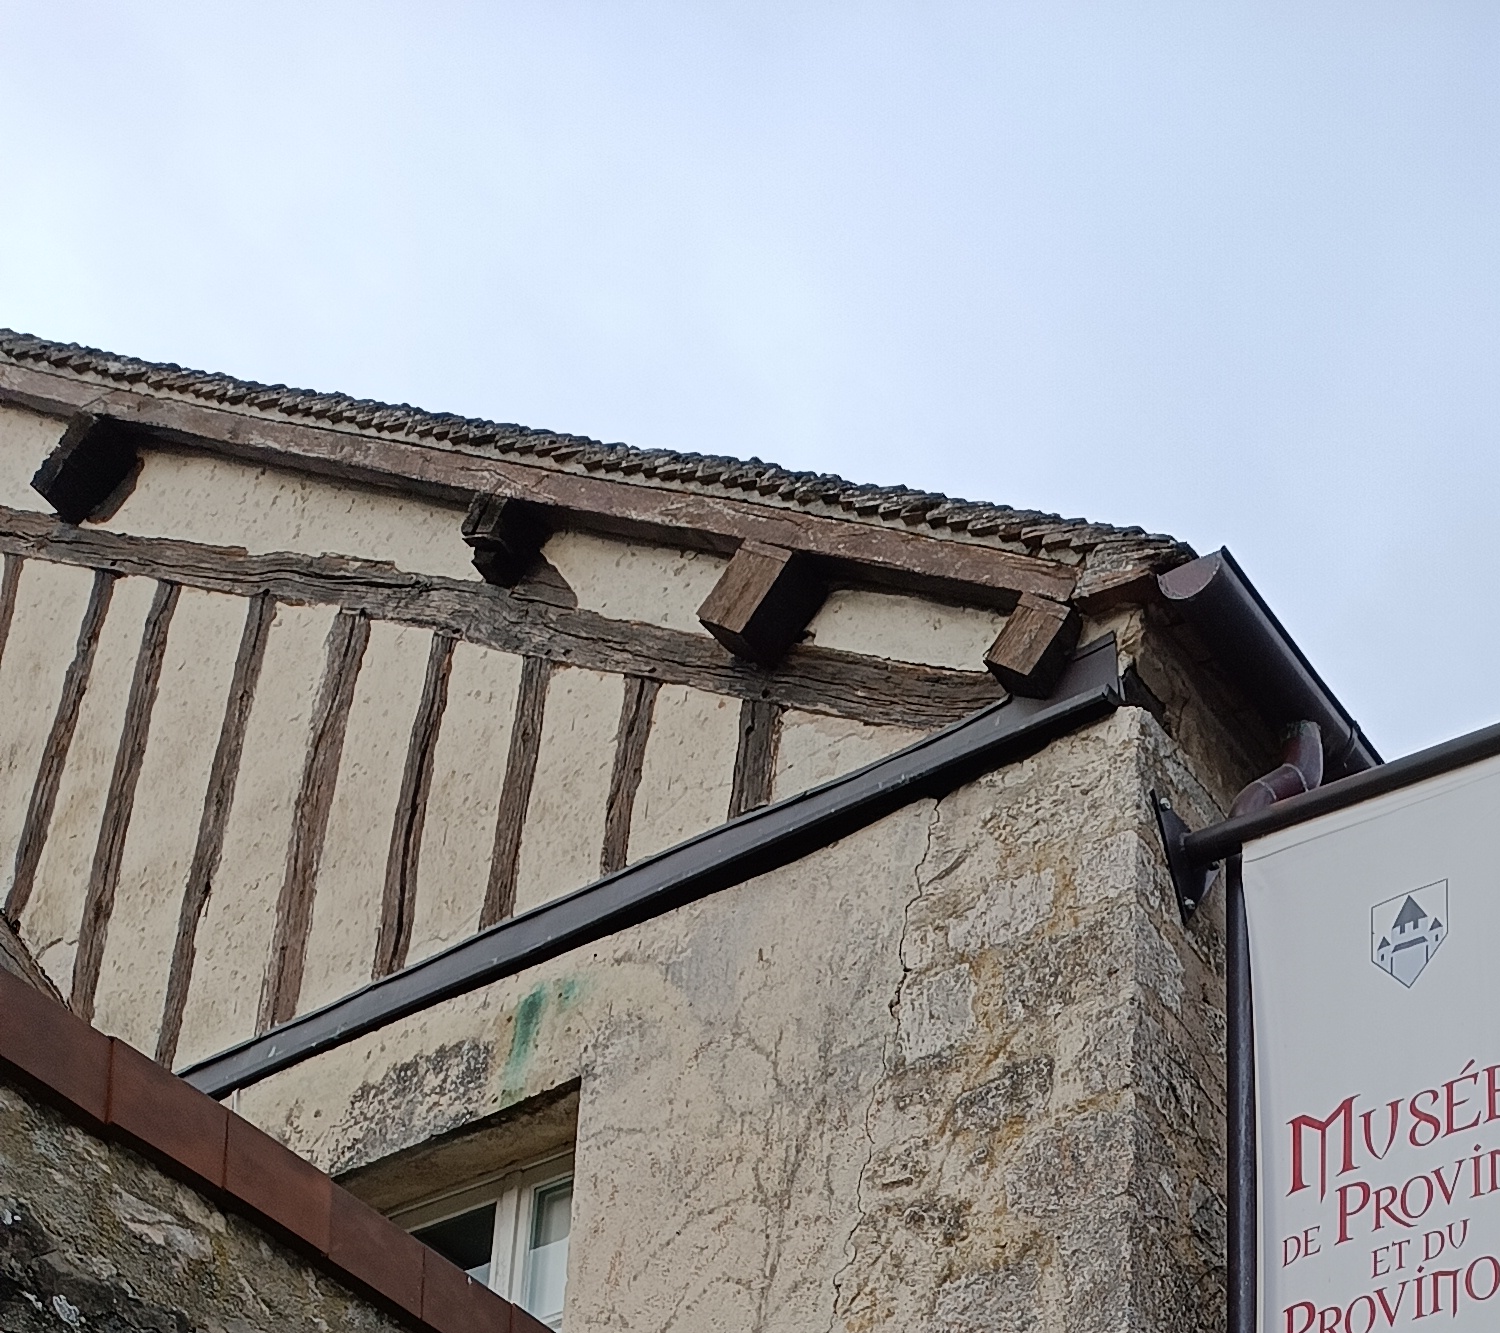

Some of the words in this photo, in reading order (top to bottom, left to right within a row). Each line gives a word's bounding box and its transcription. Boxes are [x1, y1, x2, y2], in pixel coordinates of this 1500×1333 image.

[1282, 1225, 1321, 1269] DE
[1369, 1237, 1411, 1280] ET
[1421, 1218, 1470, 1264] DU
